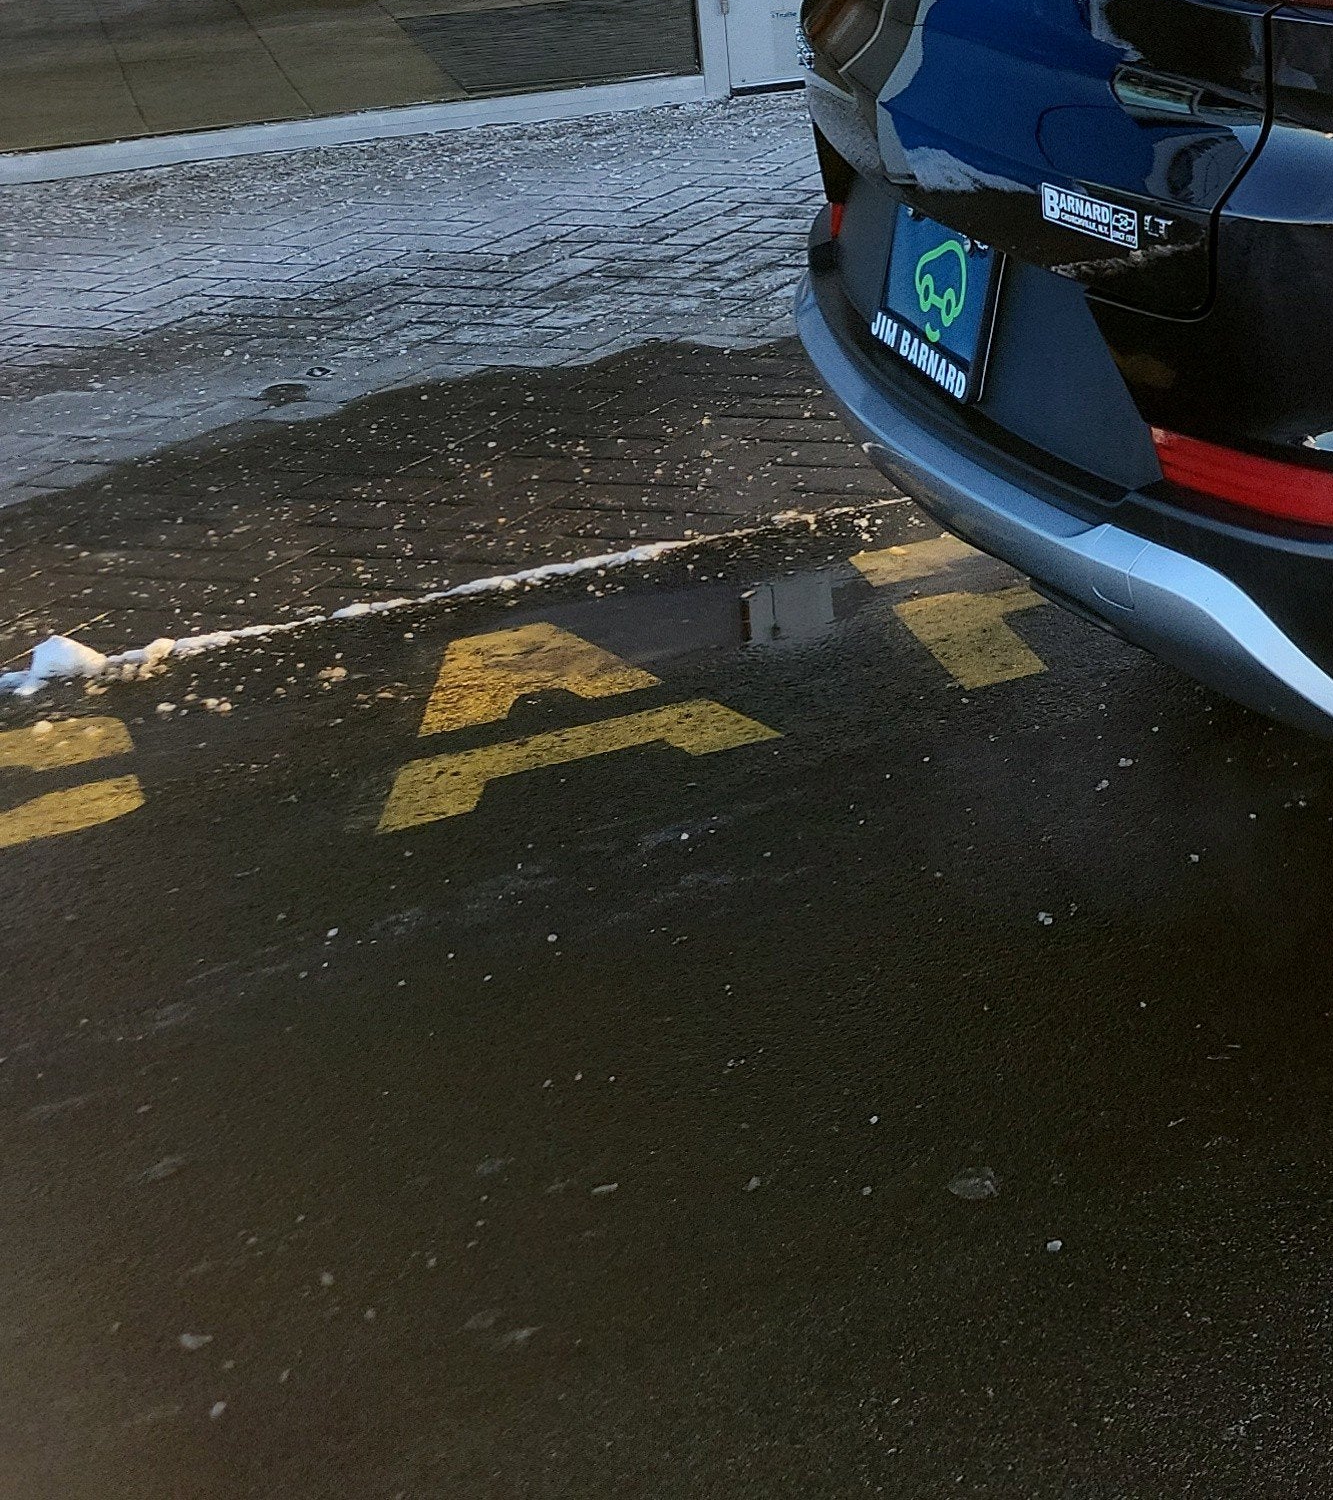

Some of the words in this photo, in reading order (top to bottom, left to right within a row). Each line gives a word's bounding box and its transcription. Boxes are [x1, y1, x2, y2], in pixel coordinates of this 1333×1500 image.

[1043, 187, 1110, 224] BARNARD
[1144, 215, 1173, 239] LT
[870, 311, 899, 348] JIM
[899, 329, 967, 399] BARNARD
